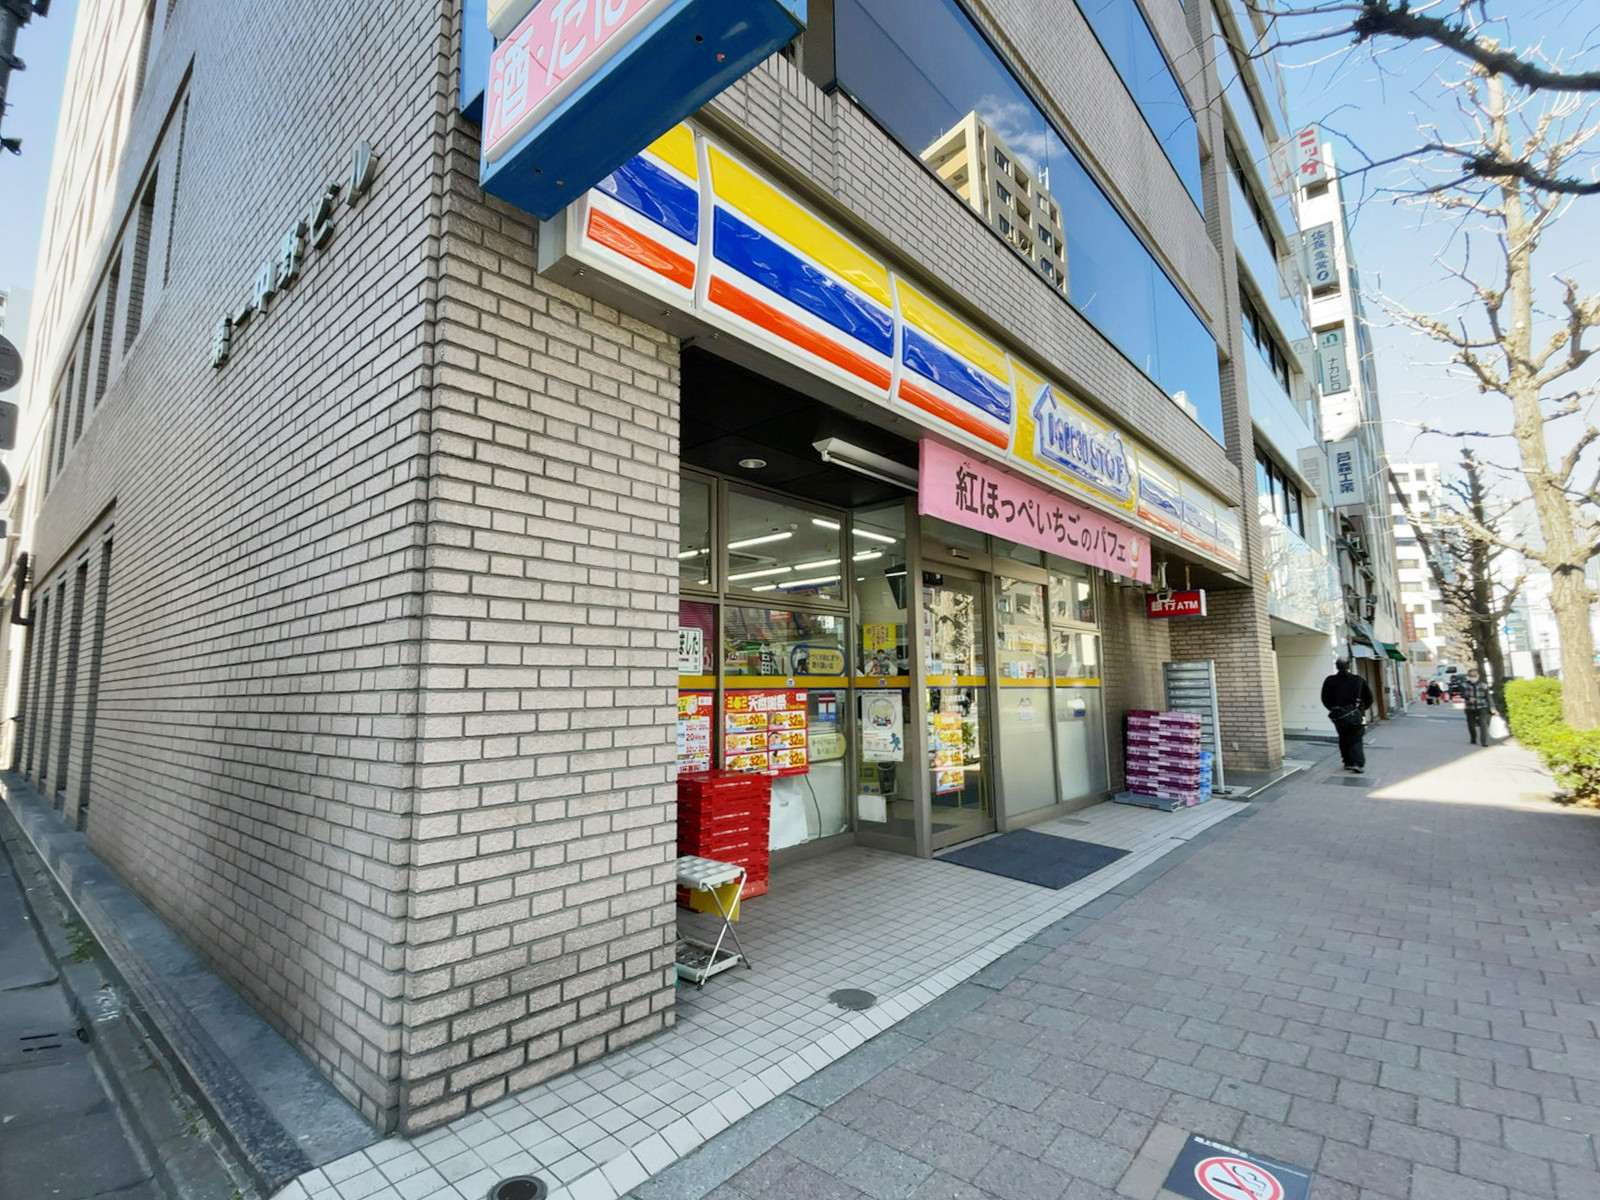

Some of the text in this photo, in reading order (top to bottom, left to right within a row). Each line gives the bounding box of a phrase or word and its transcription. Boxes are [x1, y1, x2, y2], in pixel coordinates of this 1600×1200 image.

[1328, 357, 1341, 391] ナカヒロ
[955, 464, 1128, 563] 紅ほっぺいちごのパフェ
